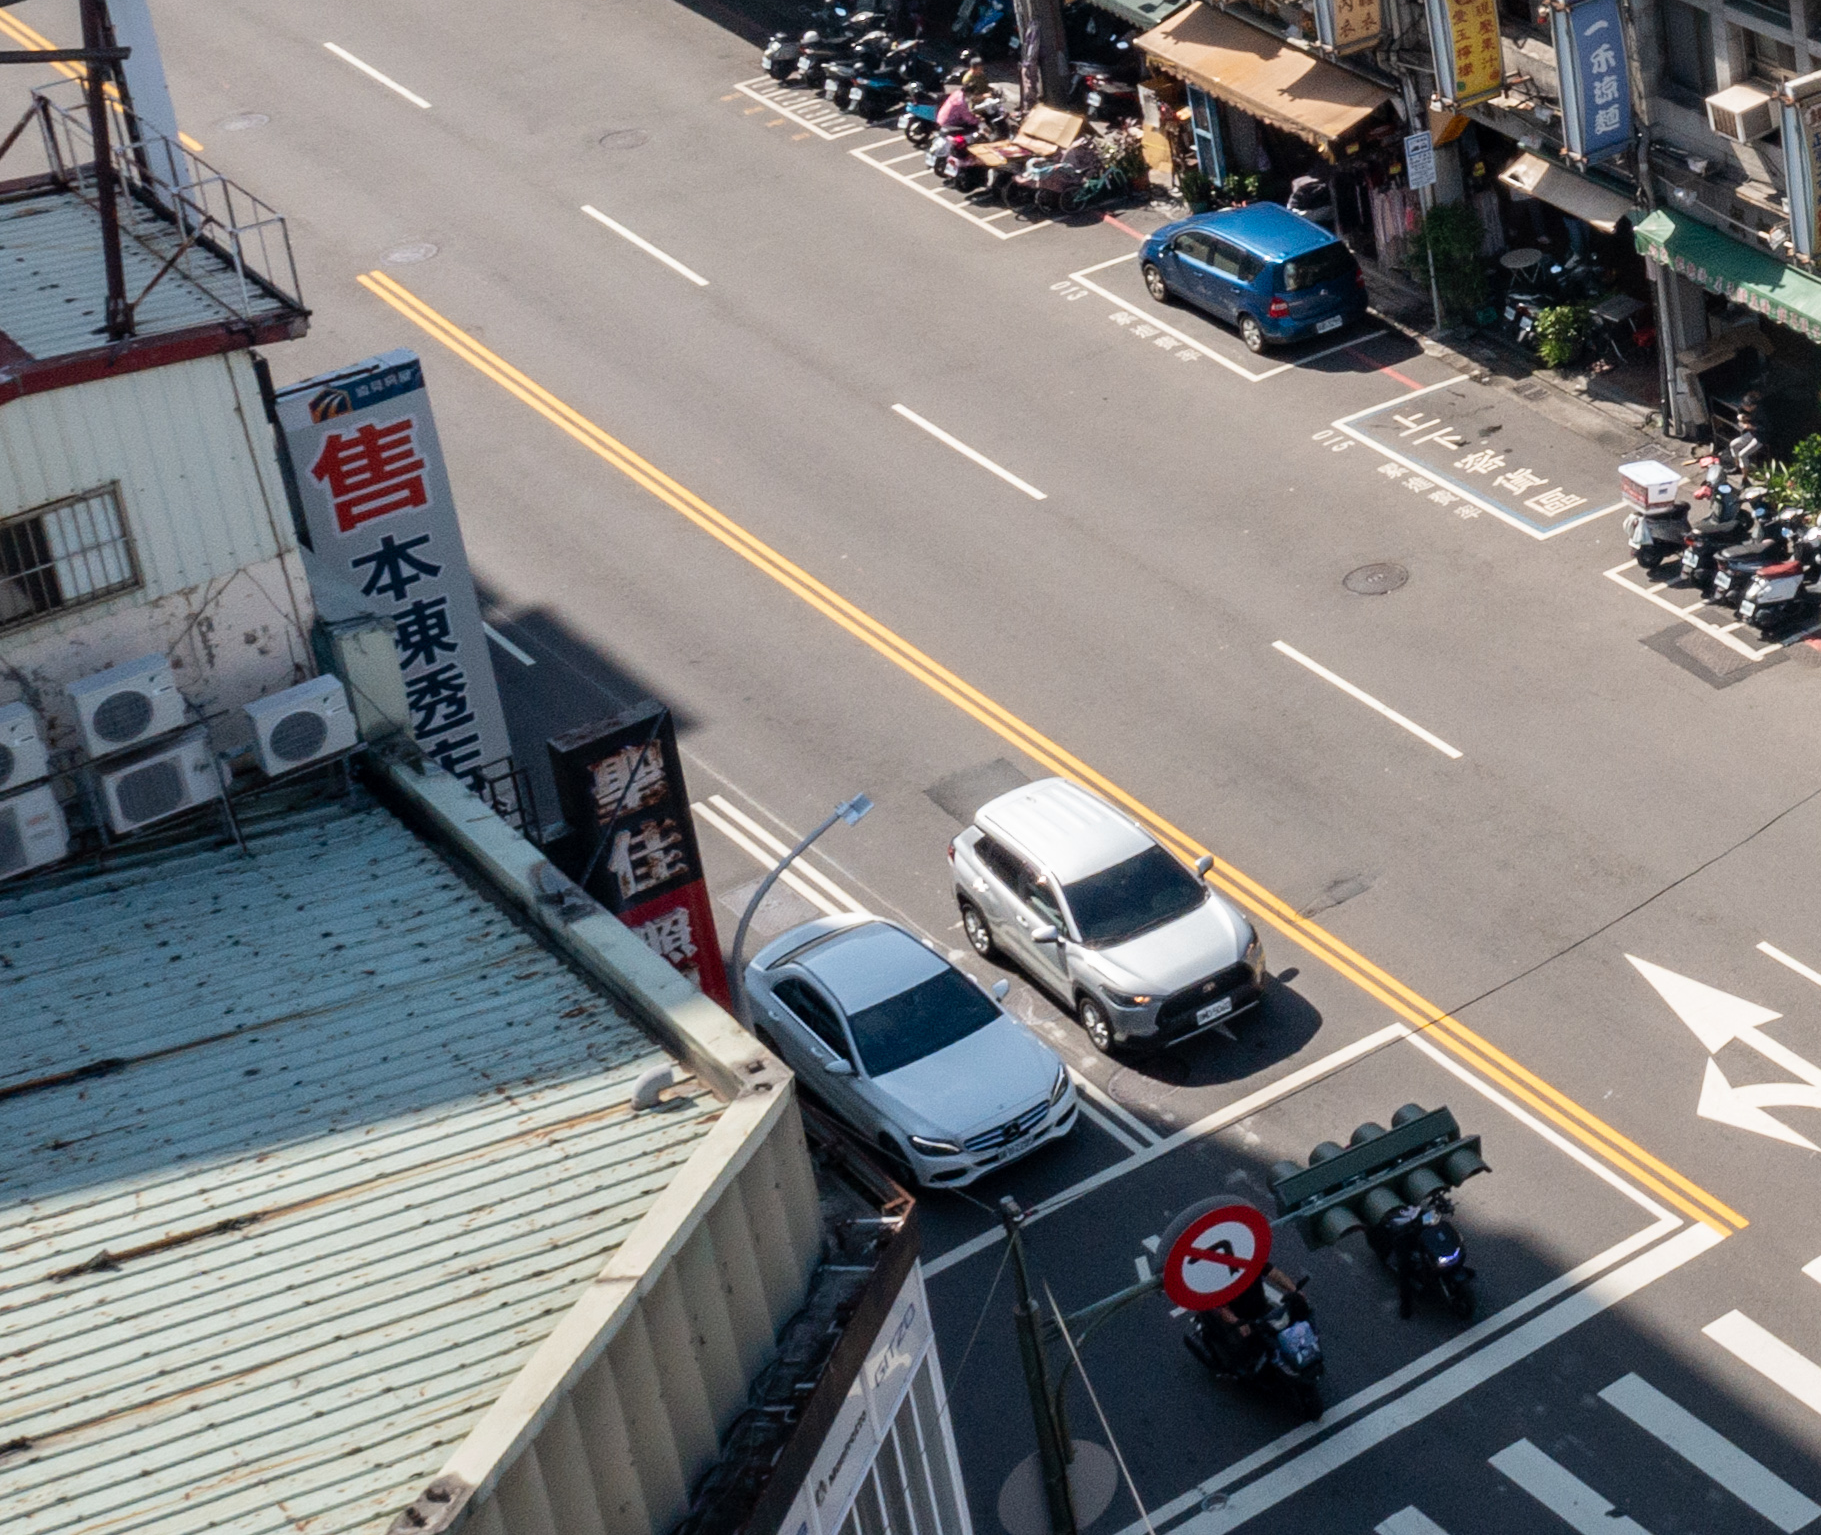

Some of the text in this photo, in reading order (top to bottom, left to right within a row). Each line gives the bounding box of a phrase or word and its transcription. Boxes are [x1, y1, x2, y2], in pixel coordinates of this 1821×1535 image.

[1049, 280, 1090, 302] 013
[1310, 428, 1357, 454] 015
[311, 418, 429, 533] 售
